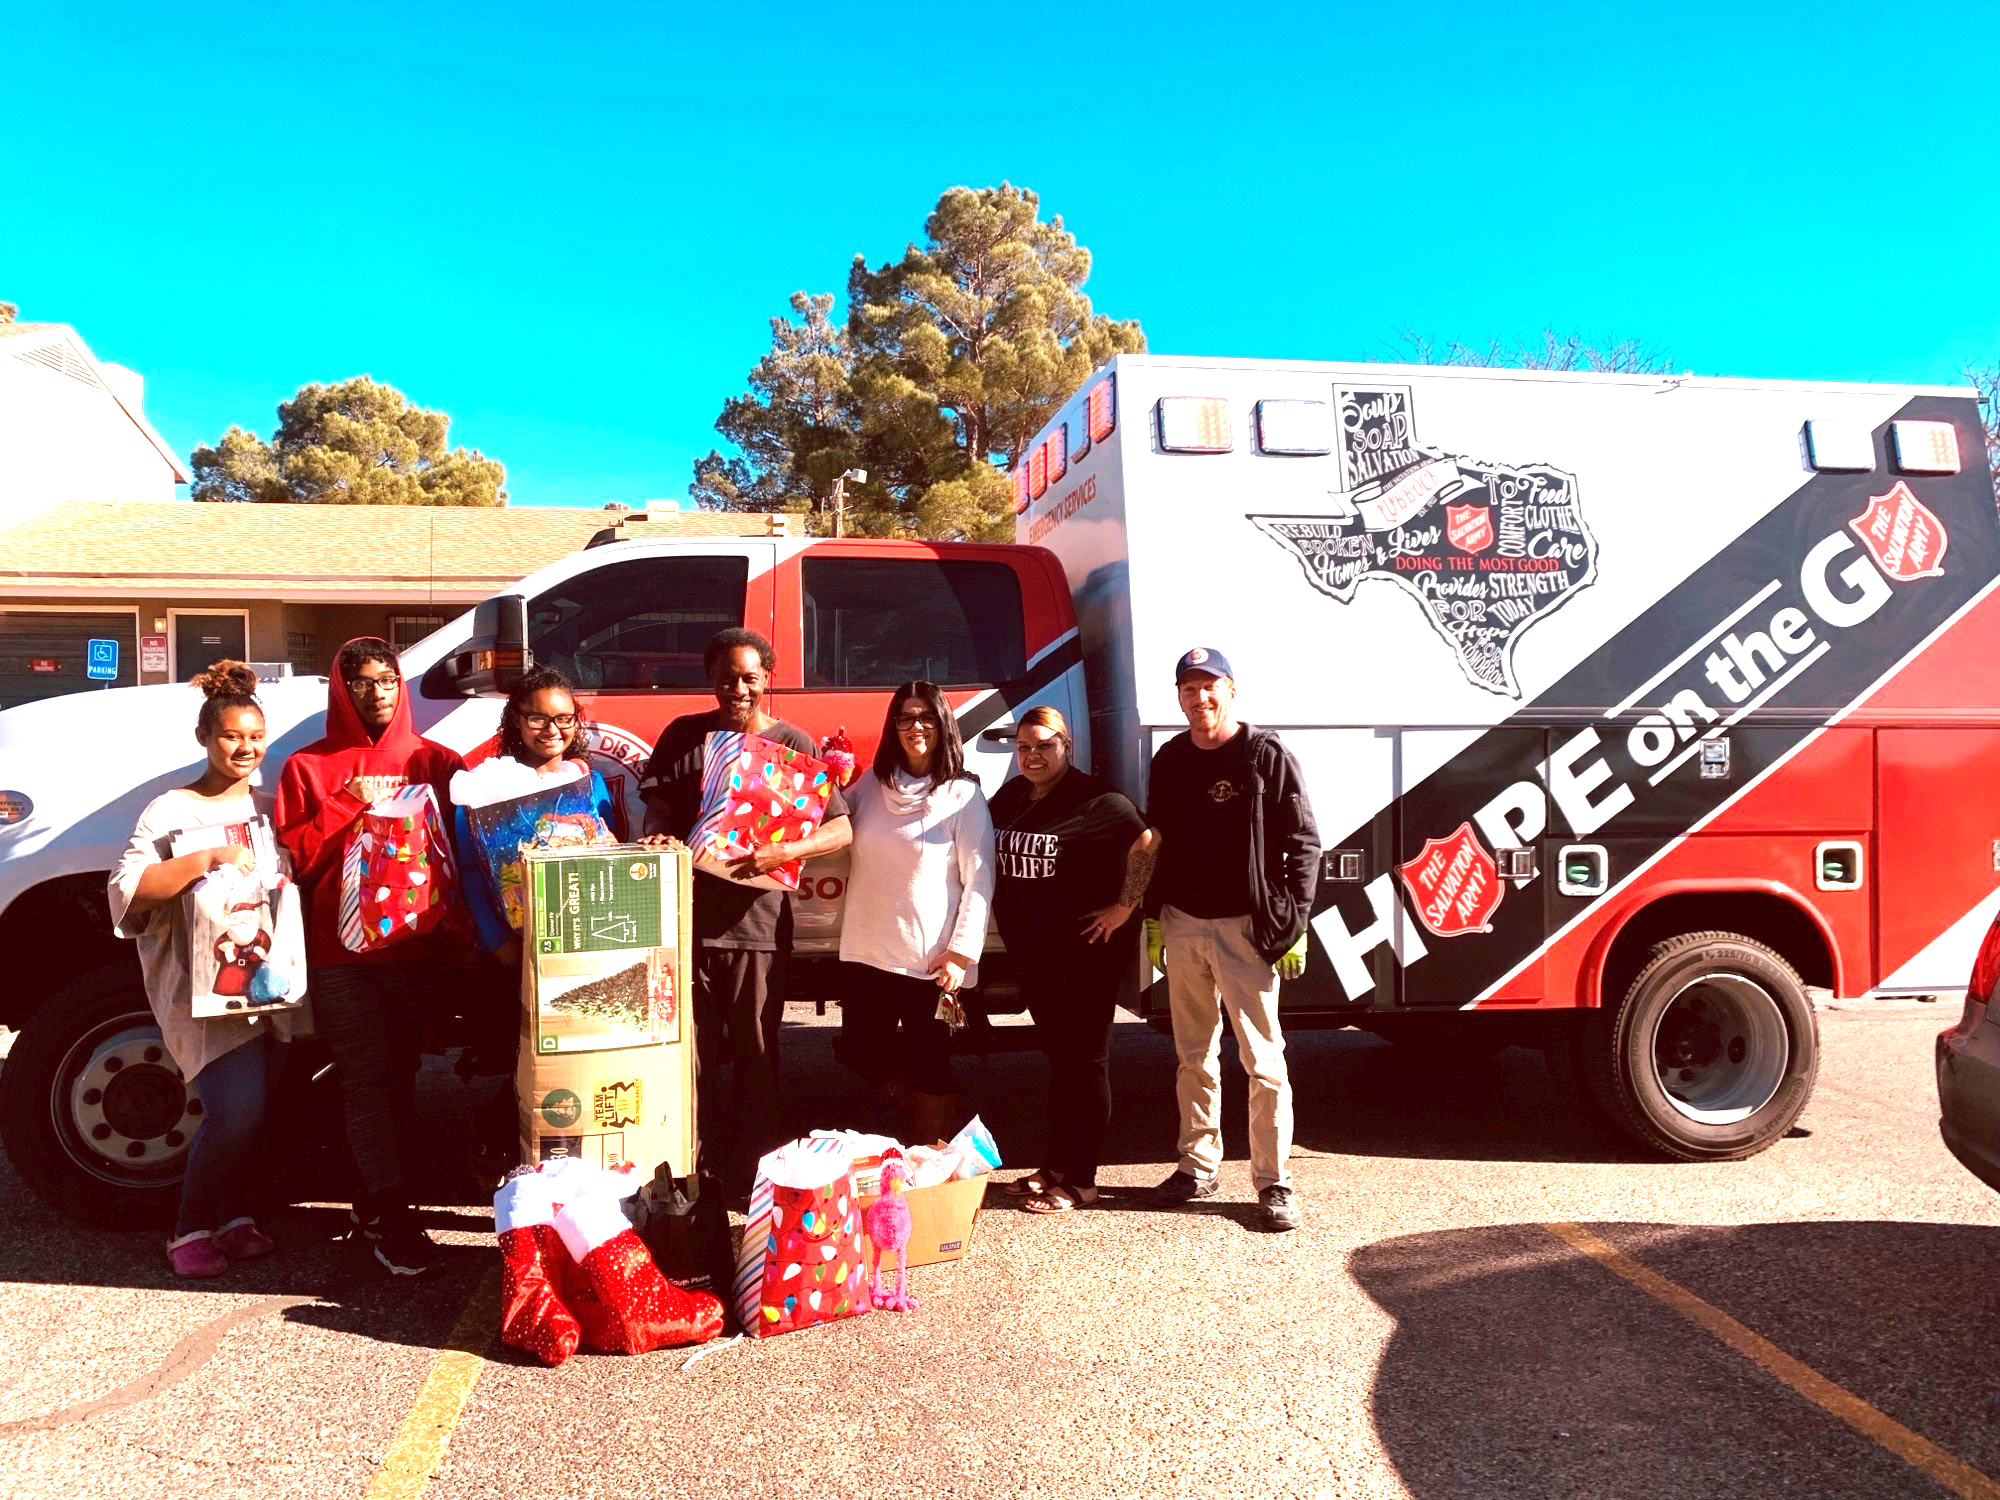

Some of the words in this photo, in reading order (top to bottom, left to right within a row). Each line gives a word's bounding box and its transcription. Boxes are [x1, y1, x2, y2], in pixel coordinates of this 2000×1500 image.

[1341, 392, 1402, 433] Soup
[1352, 411, 1409, 453] SOAP
[1346, 448, 1420, 488] SALVATION
[1376, 469, 1440, 522] LUBBOCK
[1482, 473, 1519, 506] TO
[1516, 476, 1571, 505] Feed
[1030, 500, 1063, 545] EMERGENCY
[1064, 473, 1097, 520] SERVICES
[1455, 510, 1471, 525] THE
[1524, 504, 1582, 535] CLOTHE
[1871, 505, 1892, 542] THE
[1273, 523, 1343, 539] REBUILD
[1450, 512, 1486, 542] SALVATION
[1465, 525, 1487, 548] ARMY
[1496, 498, 1527, 558] COMFORT
[1882, 494, 1916, 573] SALVATION
[1907, 515, 1930, 571] ARMY
[1298, 533, 1376, 558] BROKEN
[1313, 555, 1373, 585] Homes
[1387, 526, 1442, 559] Lives
[1527, 529, 1588, 569] Care
[1395, 557, 1443, 571] DOING
[1447, 557, 1475, 571] THE
[1479, 557, 1516, 572] MOST
[1517, 558, 1560, 572] GOOD
[1413, 570, 1490, 600] Provides
[1489, 570, 1570, 598] STRENGTH
[1429, 599, 1487, 623] FOR
[1486, 595, 1537, 628] TODAY
[1447, 620, 1511, 642] Hope
[1461, 641, 1507, 686] TOMORROW
[1474, 637, 1503, 667] FOR
[88, 665, 117, 675] PARKING
[1627, 689, 1720, 768] on
[1704, 604, 1817, 703] the
[1010, 831, 1059, 857] WIFE
[1010, 854, 1056, 879] LIFE
[1418, 849, 1447, 892] THE
[1426, 837, 1477, 927] SALVATION
[568, 872, 580, 915] GREAT!
[1454, 863, 1490, 926] ARMY
[572, 917, 581, 931] IT'S
[544, 940, 552, 952] 7.5
[573, 932, 581, 950] WHY
[595, 1093, 604, 1120] TEAM
[604, 1093, 615, 1120] LIFT
